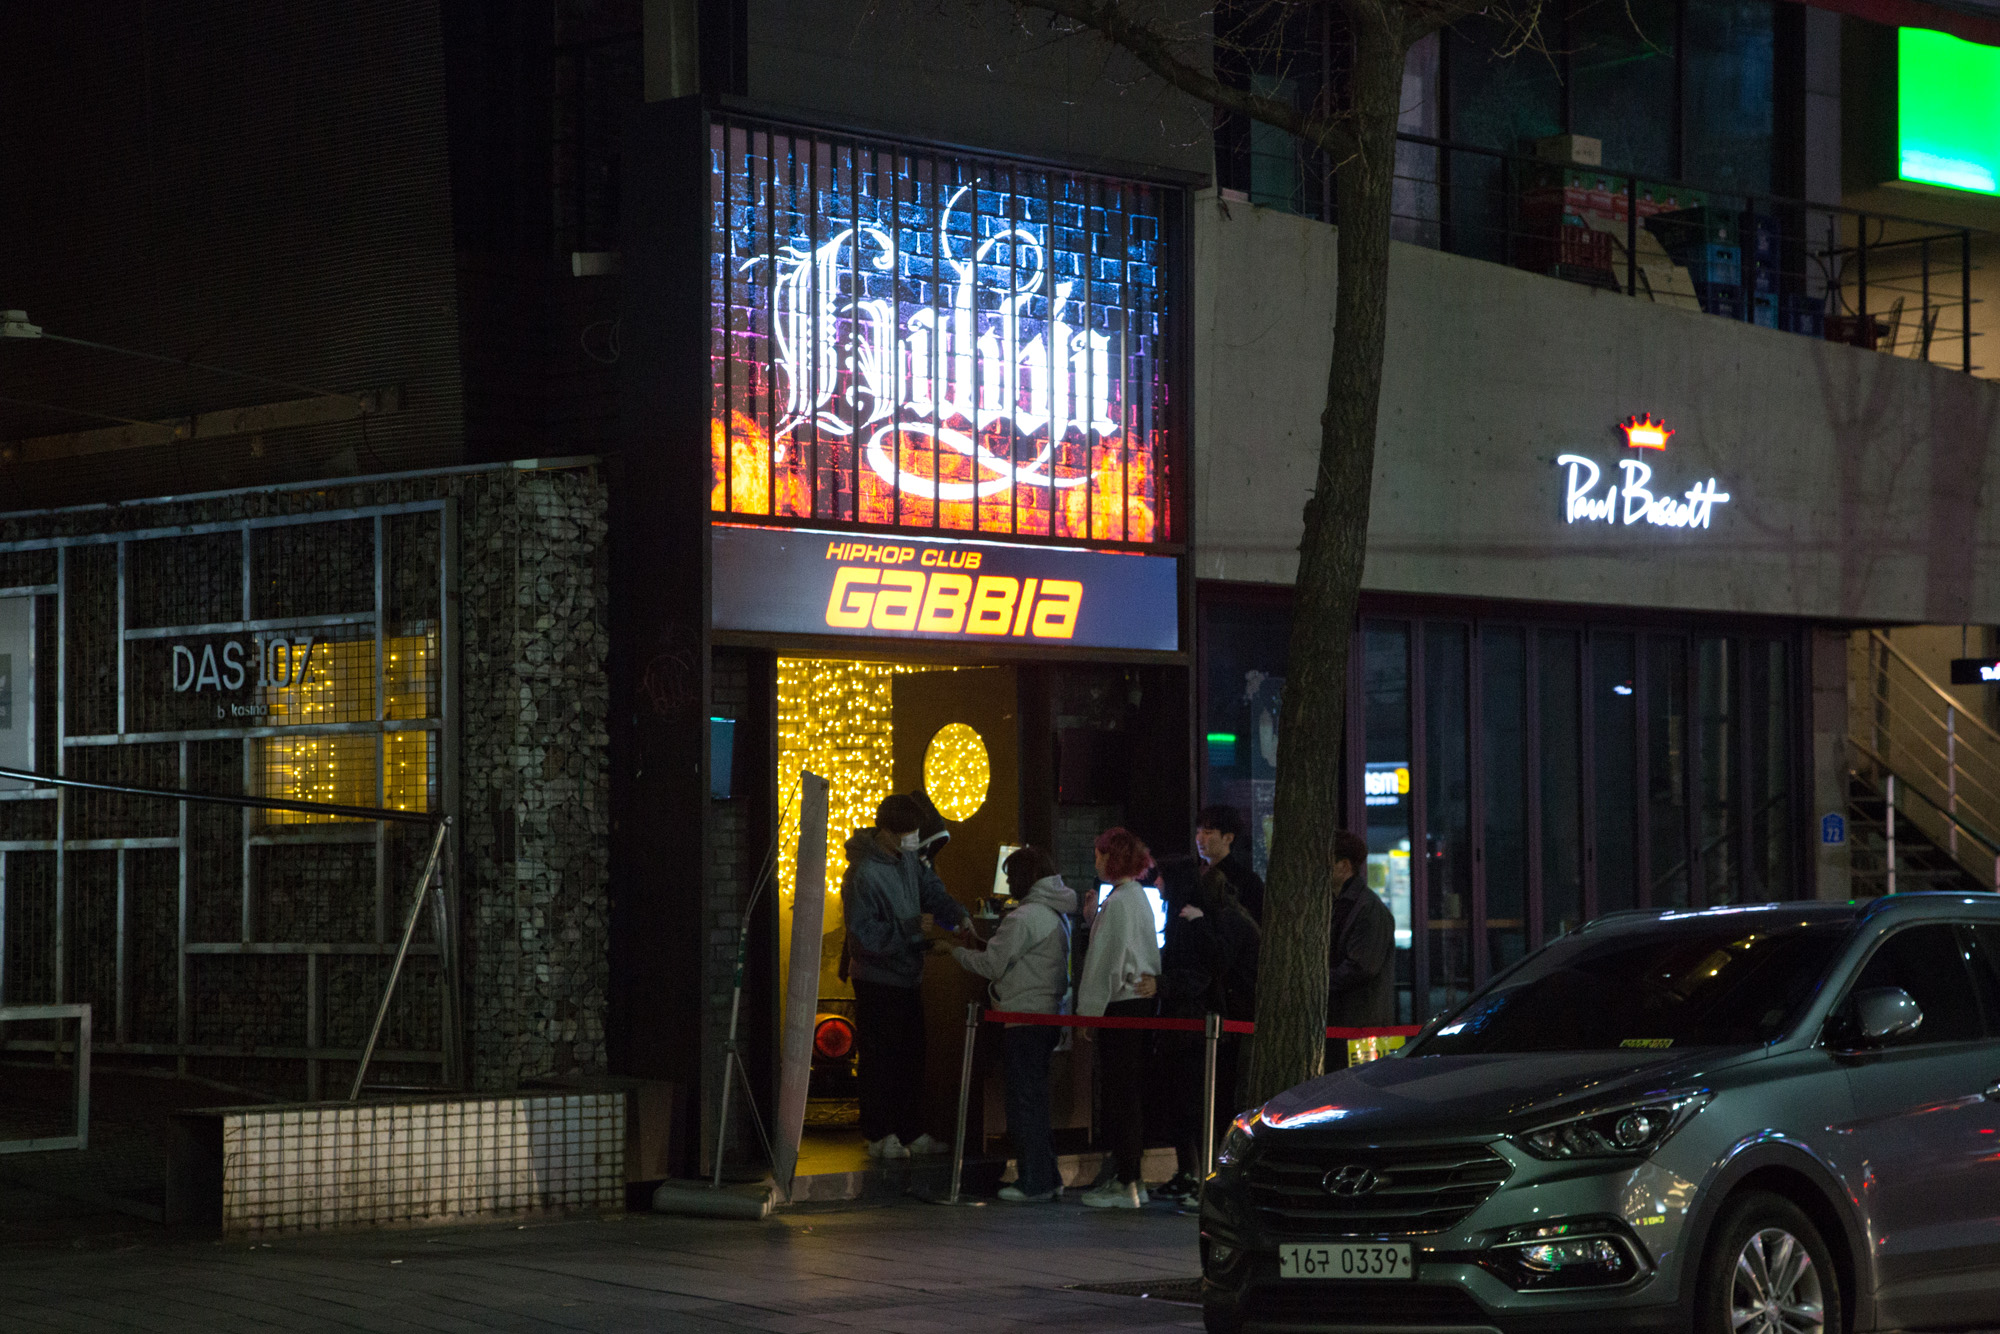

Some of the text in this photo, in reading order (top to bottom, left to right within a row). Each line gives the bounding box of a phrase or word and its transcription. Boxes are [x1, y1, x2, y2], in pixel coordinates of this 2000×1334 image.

[1557, 454, 1730, 529] Paul Bassett
[825, 542, 983, 569] HIPHOP CLUB
[1291, 1248, 1398, 1274] 16구 0339
